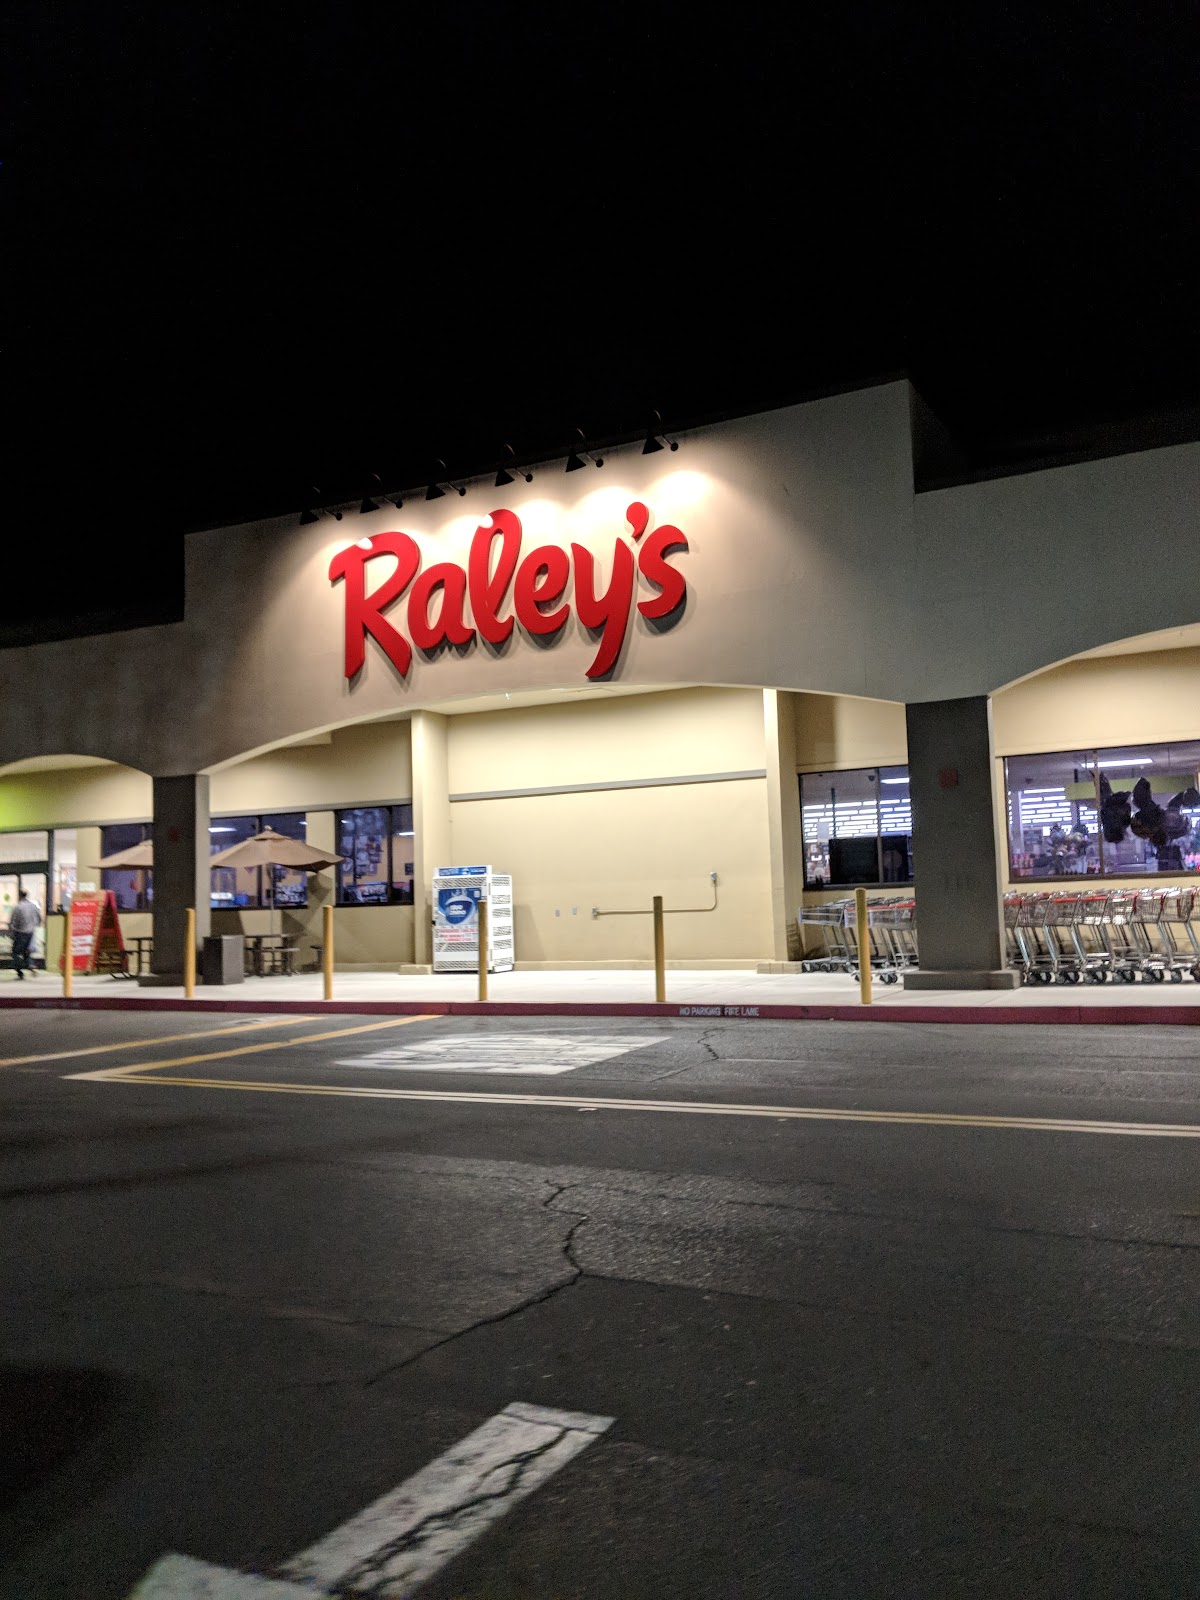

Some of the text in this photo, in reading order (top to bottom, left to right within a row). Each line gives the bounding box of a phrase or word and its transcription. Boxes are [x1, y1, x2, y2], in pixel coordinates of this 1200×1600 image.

[329, 501, 689, 678] Raley's
[680, 1006, 759, 1016] NO PARKING FIRE LANE
